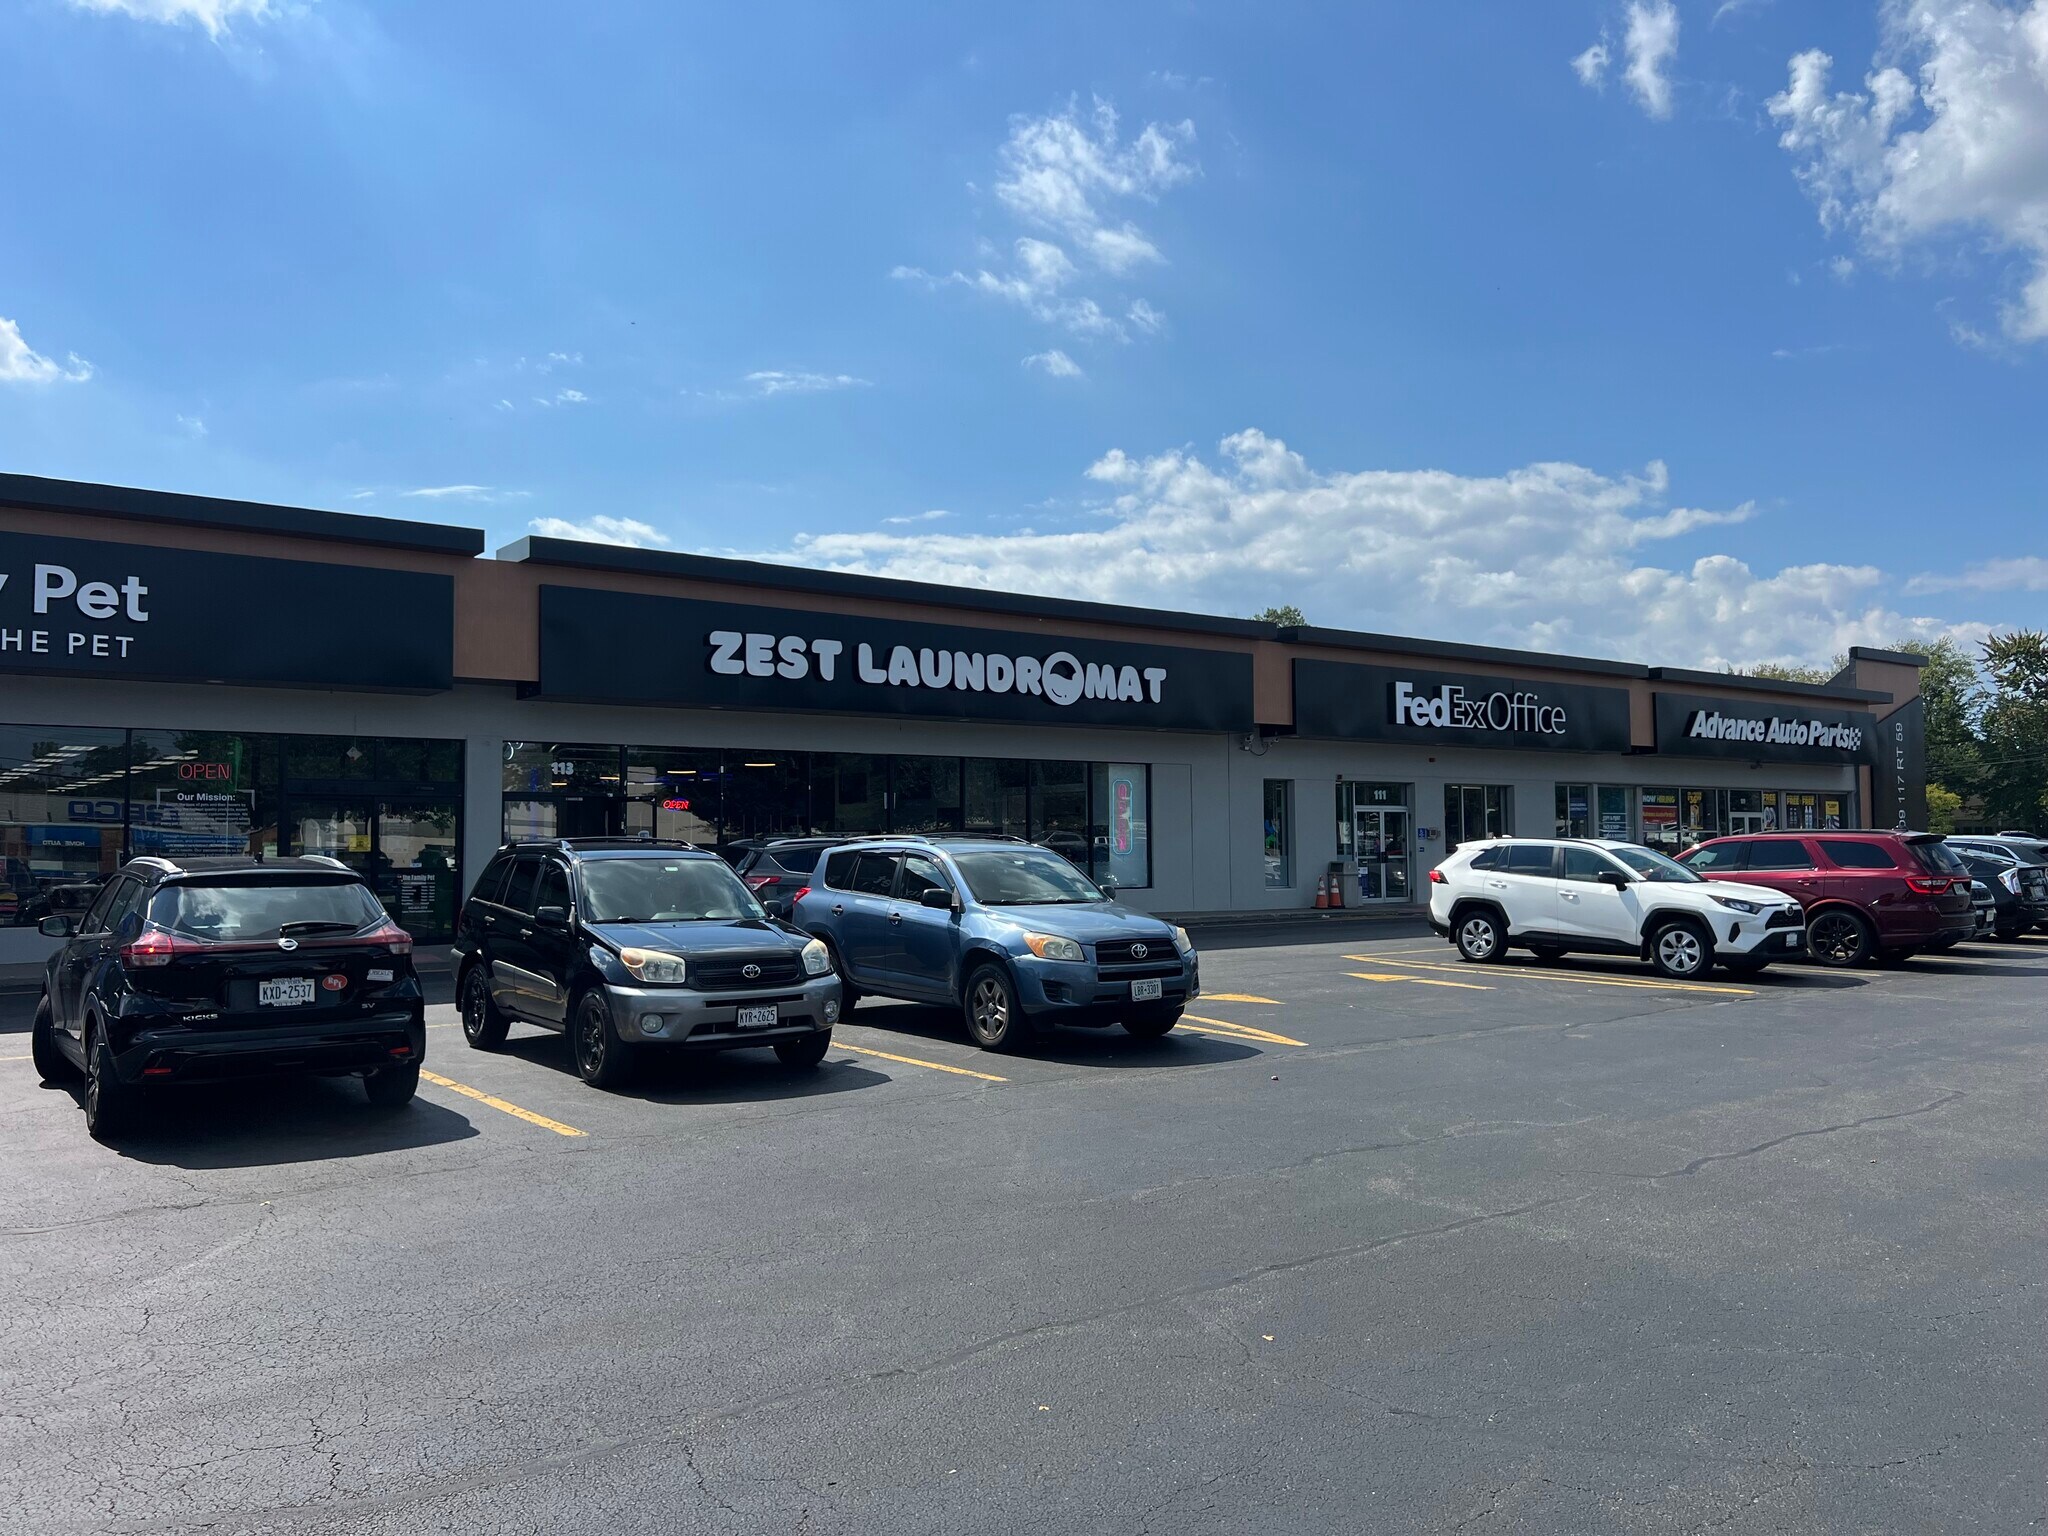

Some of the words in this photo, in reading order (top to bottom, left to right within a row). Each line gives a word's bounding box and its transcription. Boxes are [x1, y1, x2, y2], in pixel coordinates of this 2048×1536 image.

[33, 563, 149, 622] Pet
[1, 628, 49, 654] HE
[68, 632, 134, 659] PET
[709, 630, 843, 682] ZEST
[857, 642, 1167, 706] LAUNDROMAT
[1689, 710, 1765, 742] Advance
[1765, 717, 1808, 746] Auto
[1808, 720, 1850, 749] Parts
[1895, 722, 1904, 742] 59
[1896, 747, 1904, 770] RT
[180, 763, 230, 779] OPEN
[551, 762, 574, 776] 113
[177, 793, 195, 801] Our
[196, 793, 236, 802] Mission:
[1373, 790, 1387, 800] 111
[1897, 775, 1906, 804] 117
[663, 800, 690, 810] OPEN
[1642, 795, 1657, 803] NOW
[182, 1013, 219, 1021] KICKS
